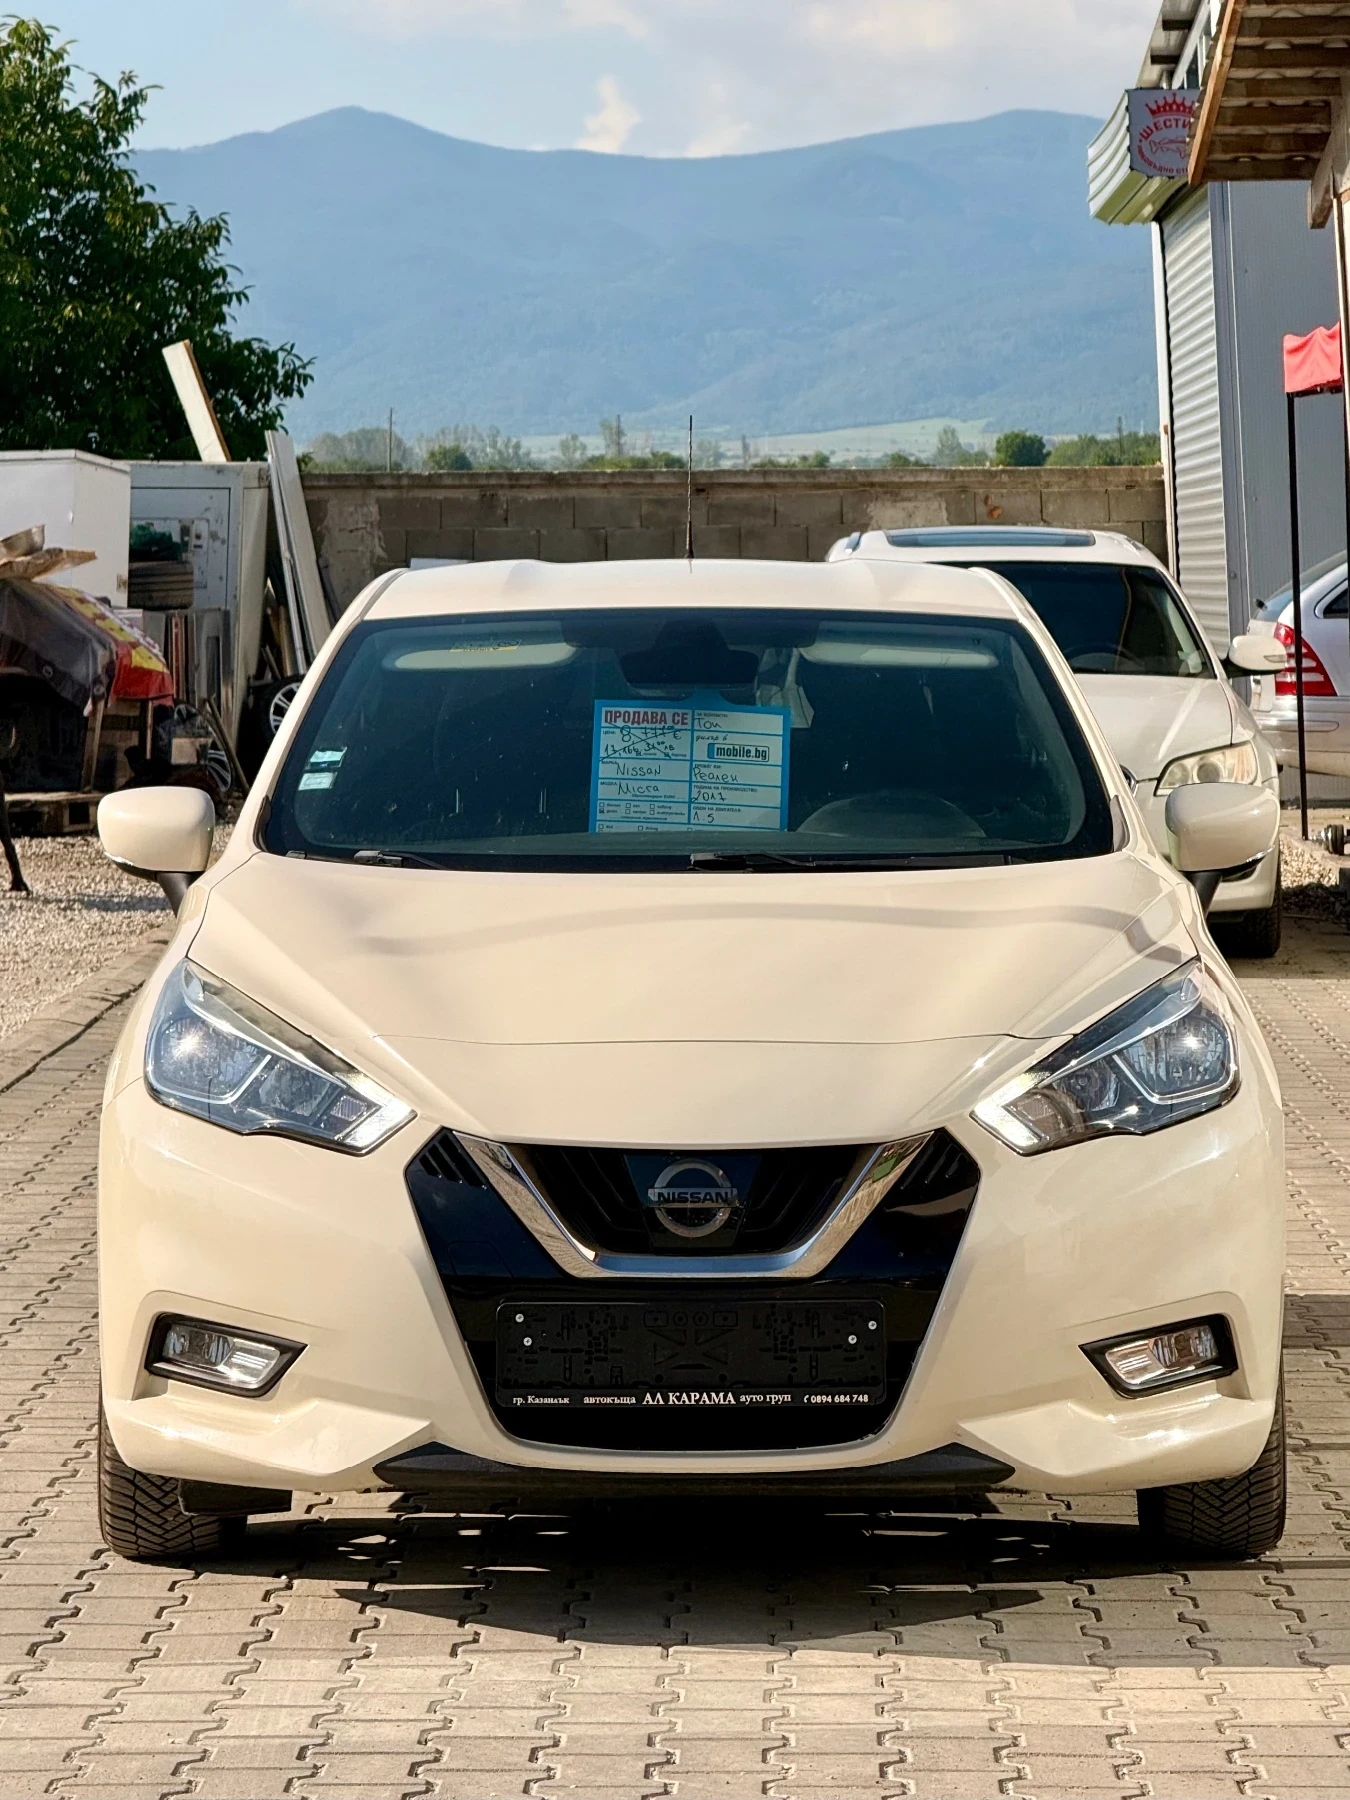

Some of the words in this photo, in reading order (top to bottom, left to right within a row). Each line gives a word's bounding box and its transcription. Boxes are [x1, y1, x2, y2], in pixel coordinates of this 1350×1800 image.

[604, 710, 667, 726] ПРОДАВА
[672, 712, 689, 726] СЕ
[716, 746, 768, 761] mobile.bg
[657, 1191, 729, 1204] NISSAN
[512, 1397, 526, 1406] гр.
[527, 1395, 570, 1404] Казанлък
[583, 1396, 636, 1405] автокъща
[642, 1392, 665, 1405] АЛ
[668, 1392, 736, 1405] КАРАМА
[739, 1393, 764, 1405] ауто
[766, 1393, 792, 1405] груп
[811, 1394, 832, 1403] 0894
[834, 1394, 850, 1403] 684
[852, 1394, 869, 1403] 748
